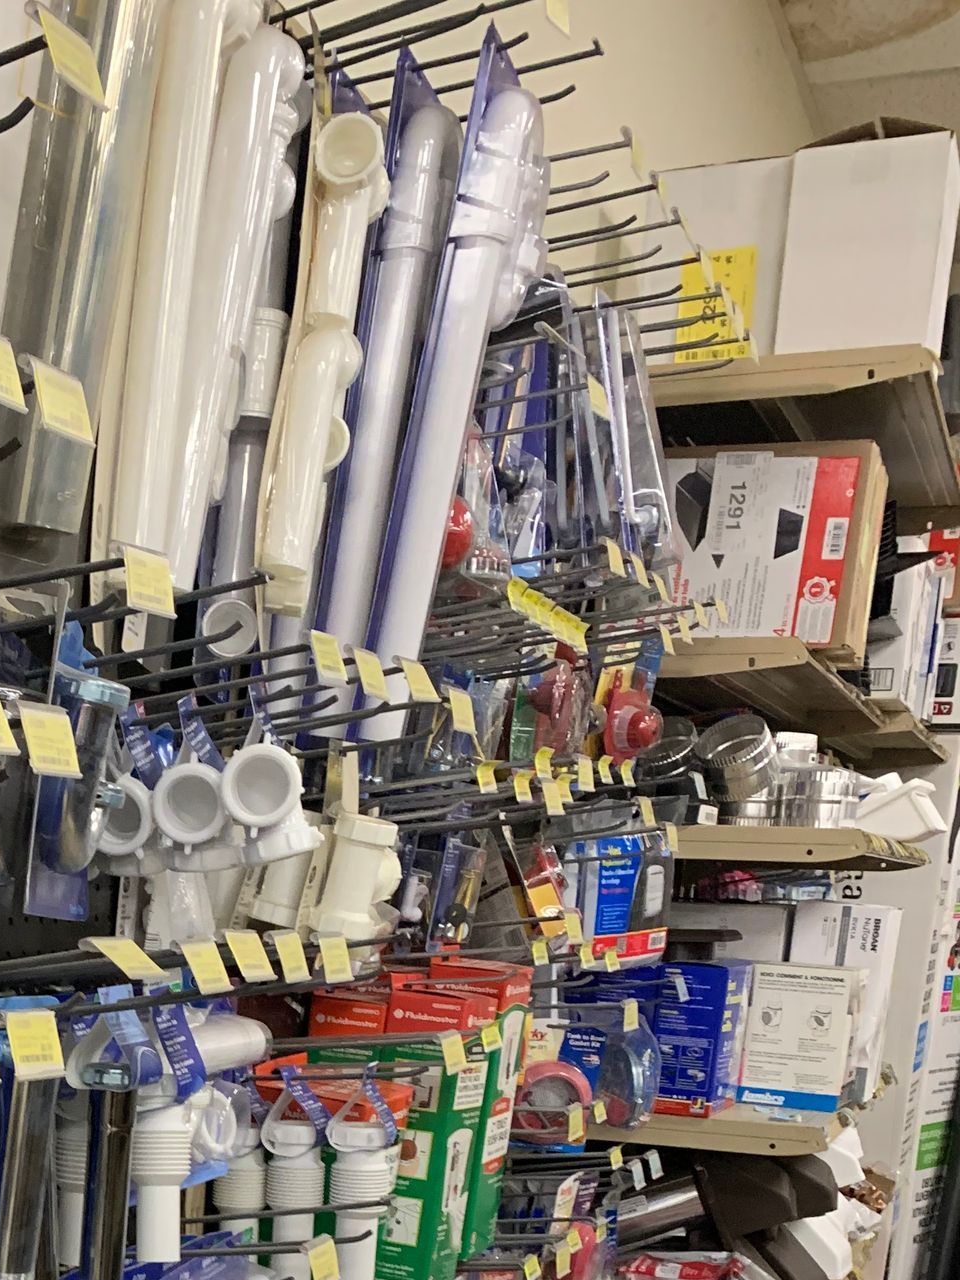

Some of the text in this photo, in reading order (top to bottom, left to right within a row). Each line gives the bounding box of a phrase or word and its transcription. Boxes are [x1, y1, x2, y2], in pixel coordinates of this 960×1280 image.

[725, 481, 747, 530] 1291
[859, 917, 871, 952] NuTone
[870, 918, 882, 953] BROAN
[445, 982, 499, 995] Fluidmaster
[327, 1015, 378, 1029] Fluidmaster
[404, 1010, 459, 1025] Fluidmaster
